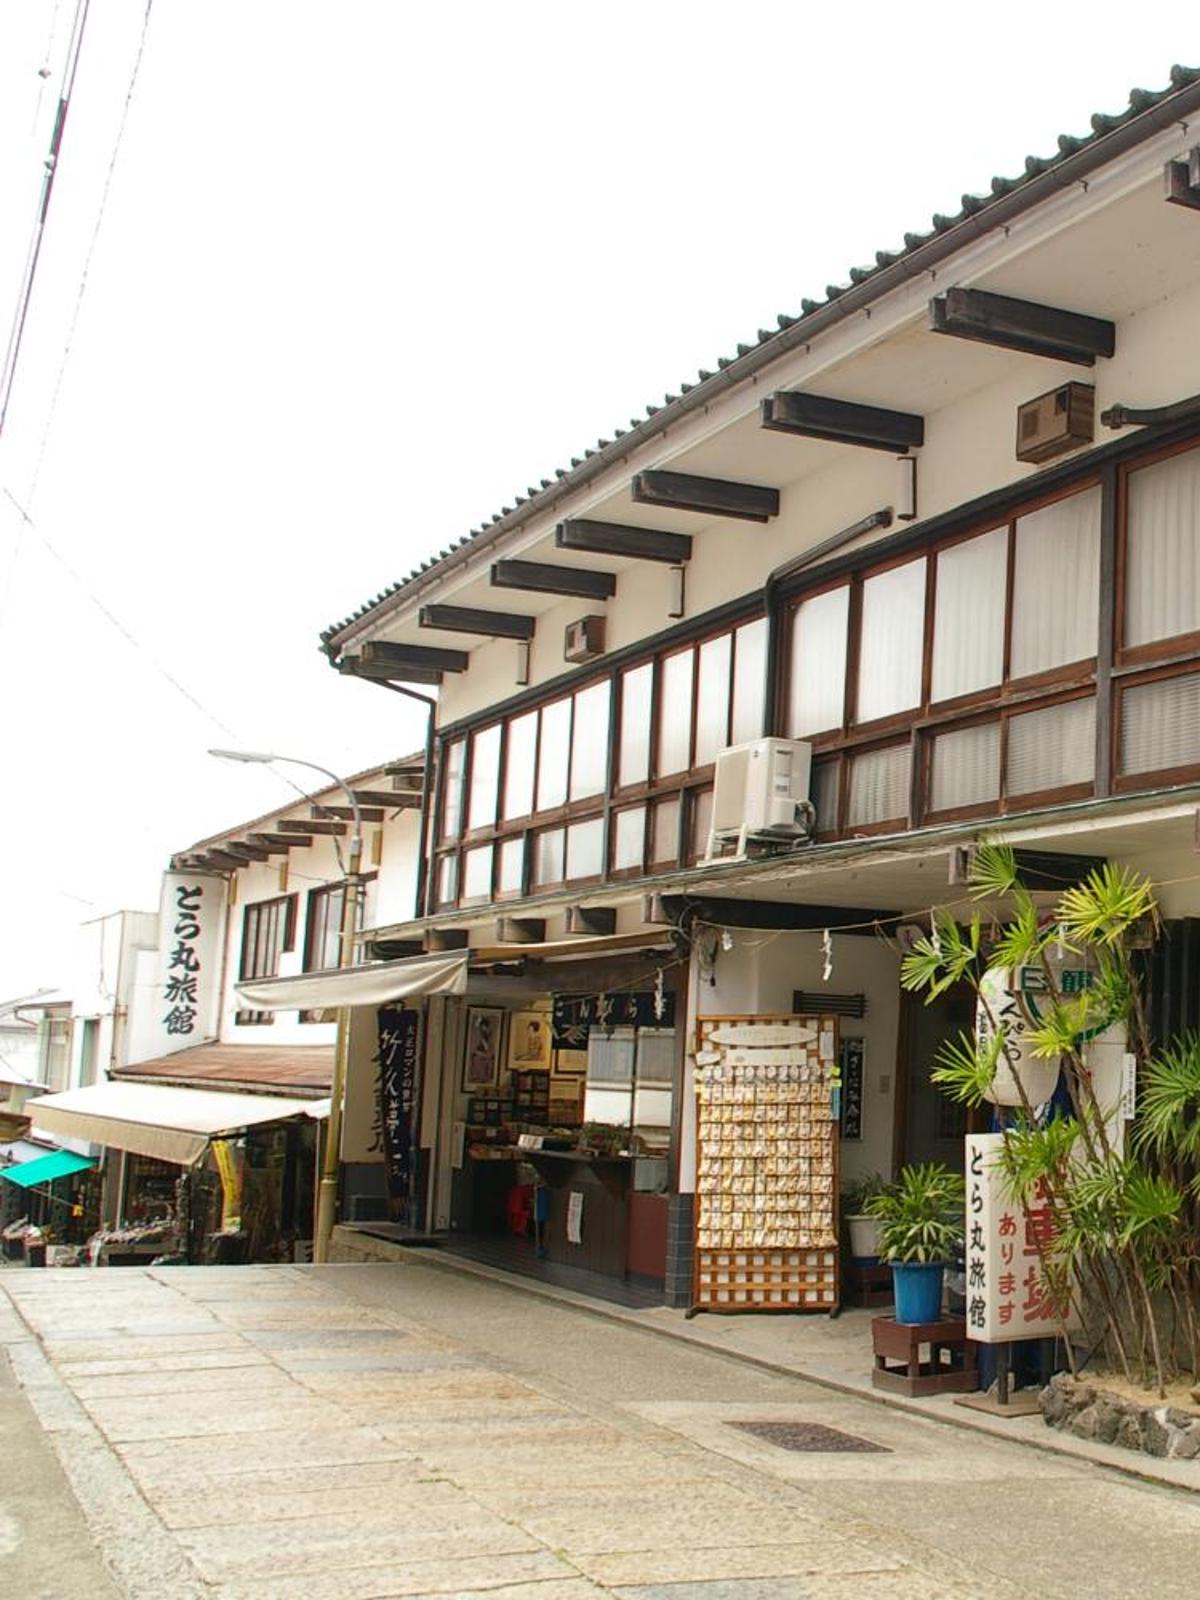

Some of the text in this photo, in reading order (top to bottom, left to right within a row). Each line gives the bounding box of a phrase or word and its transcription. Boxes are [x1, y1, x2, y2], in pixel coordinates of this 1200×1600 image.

[162, 885, 203, 1035] とら丸旅館
[998, 989, 1026, 1062] んぴら
[969, 1145, 987, 1329] とら丸旅館
[998, 1212, 1018, 1326] あります
